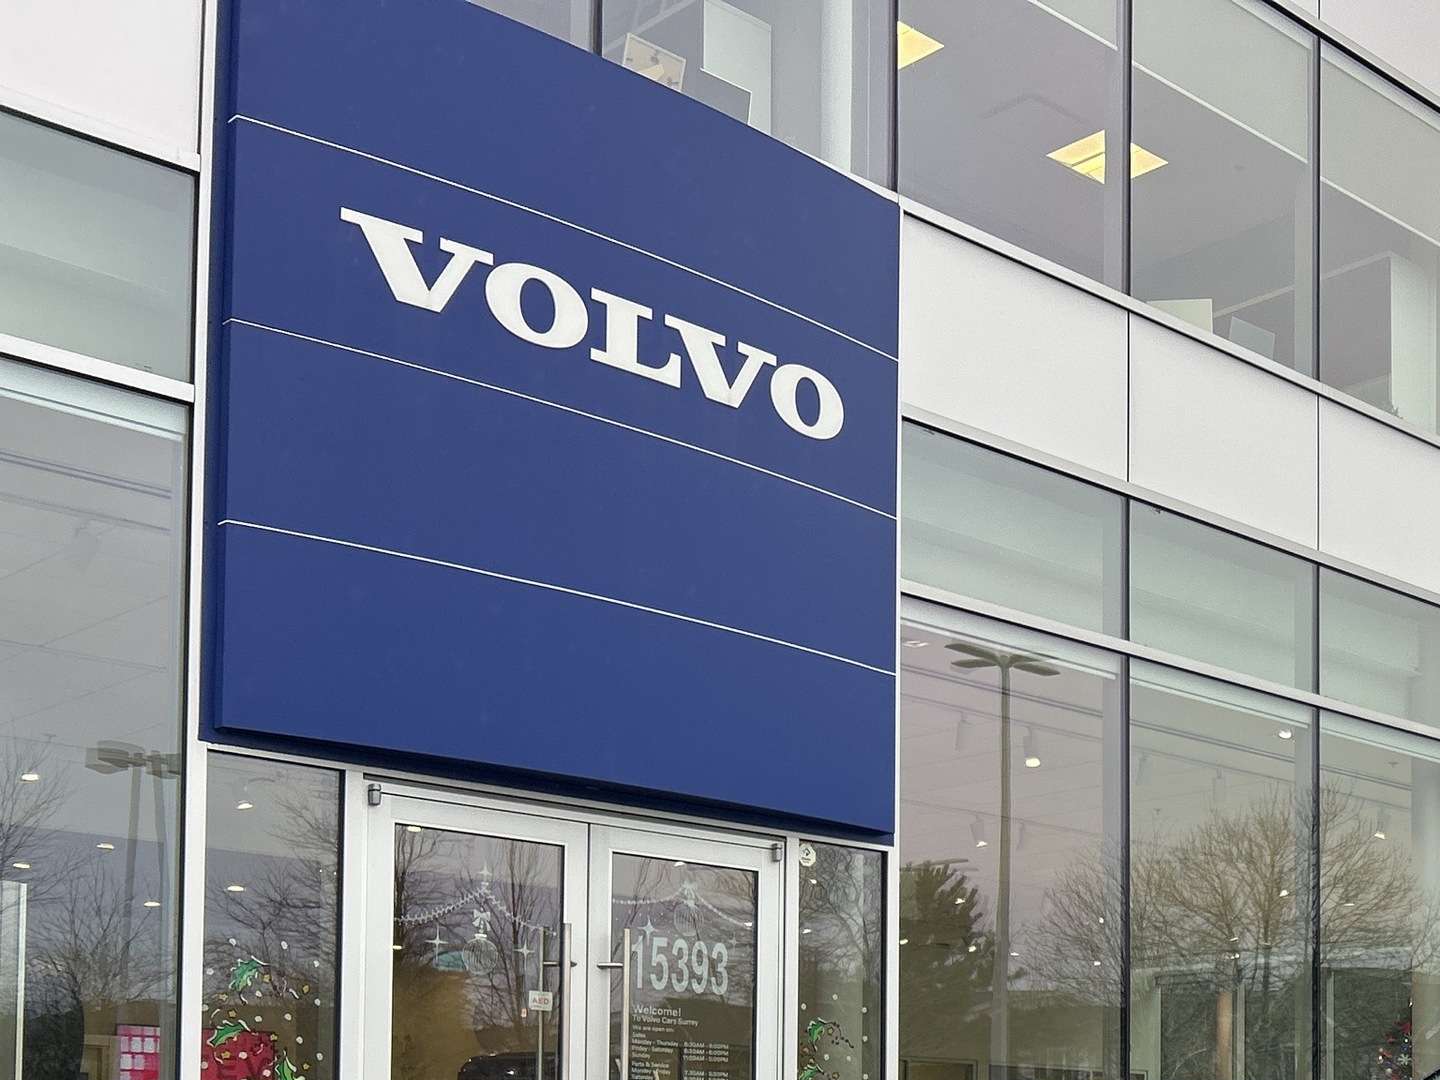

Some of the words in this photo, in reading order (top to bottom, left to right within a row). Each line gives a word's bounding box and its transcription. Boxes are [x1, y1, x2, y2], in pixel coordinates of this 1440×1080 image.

[340, 206, 845, 441] VOLVO
[632, 935, 728, 996] 15393
[632, 1005, 682, 1017] Welcome!
[642, 1014, 661, 1024] Volvo
[661, 1017, 677, 1025] Cars
